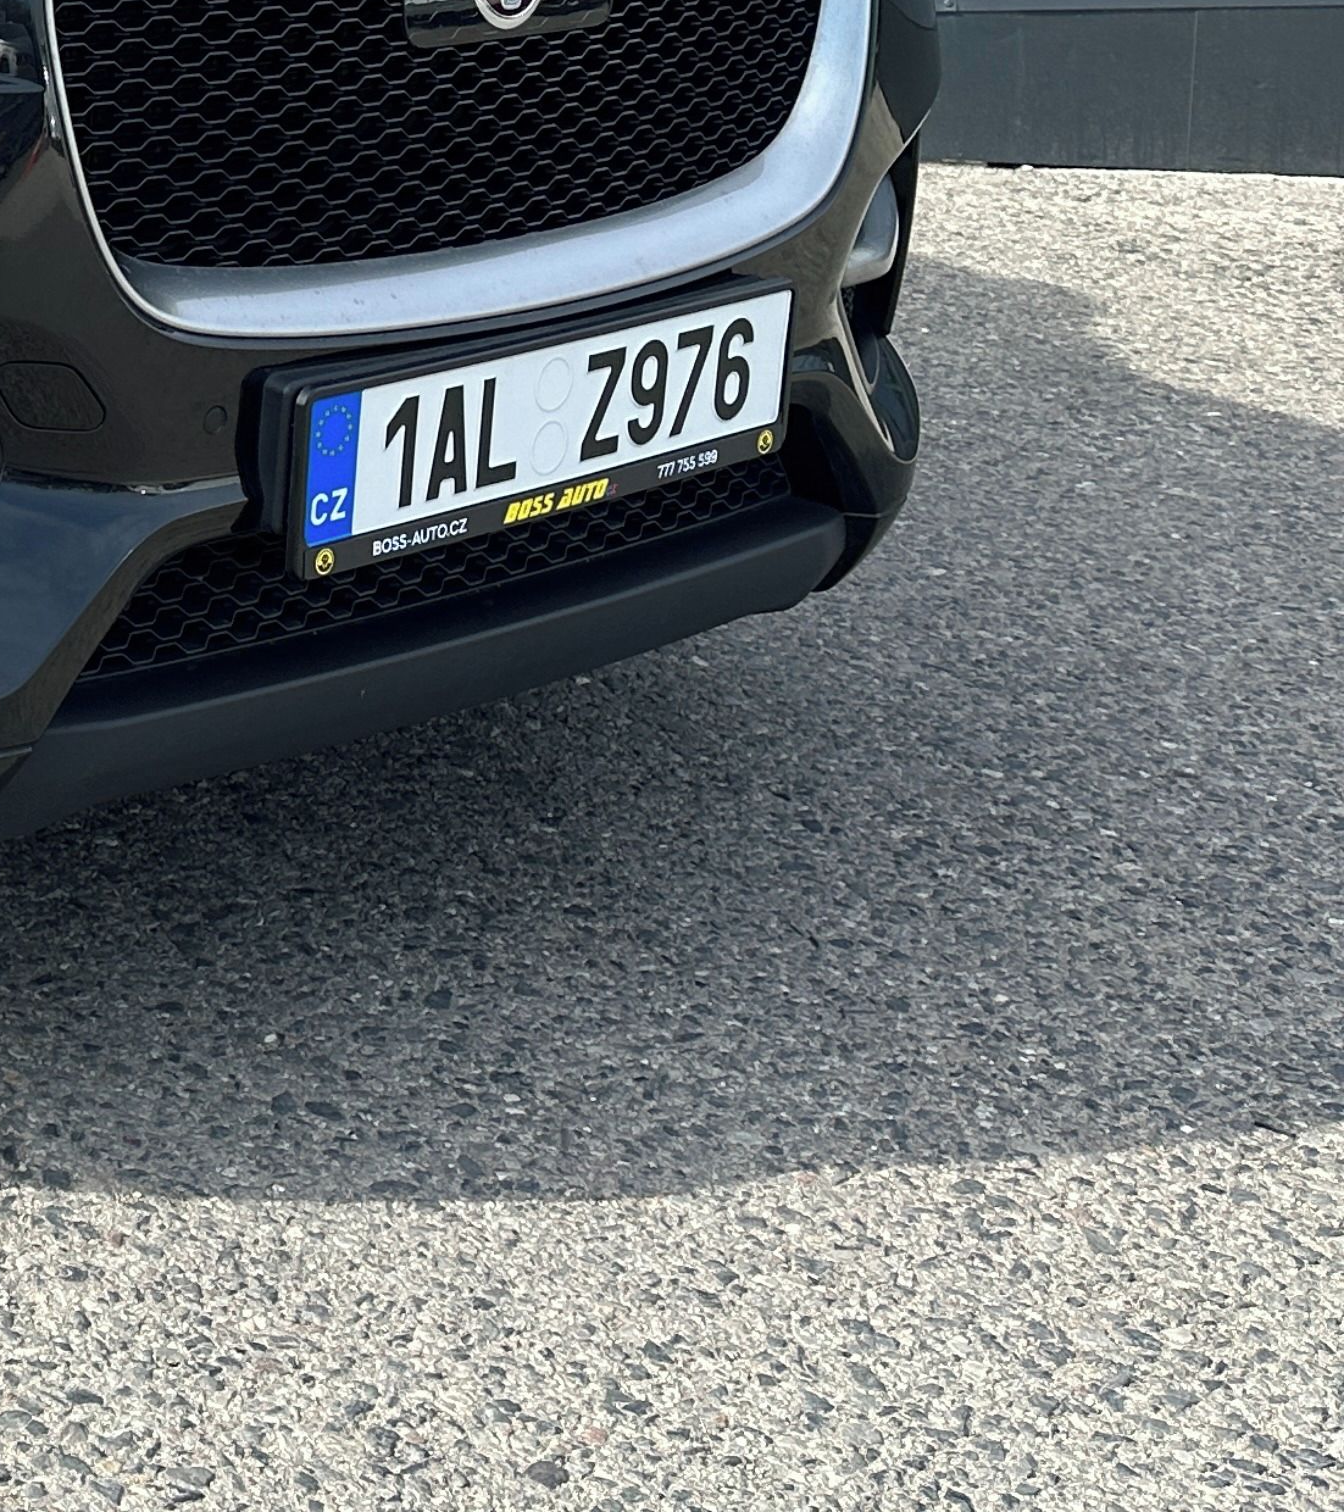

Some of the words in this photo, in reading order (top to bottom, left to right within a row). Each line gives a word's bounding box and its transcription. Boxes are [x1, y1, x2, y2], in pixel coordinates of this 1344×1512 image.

[384, 378, 516, 508] 1AL
[579, 318, 755, 461] Z976
[657, 460, 676, 479] 777
[677, 455, 696, 474] 755
[310, 488, 348, 526] CZ
[503, 492, 555, 525] BOSS
[555, 478, 609, 510] AUTO
[373, 517, 468, 556] BOSS-AUTO.CZ
